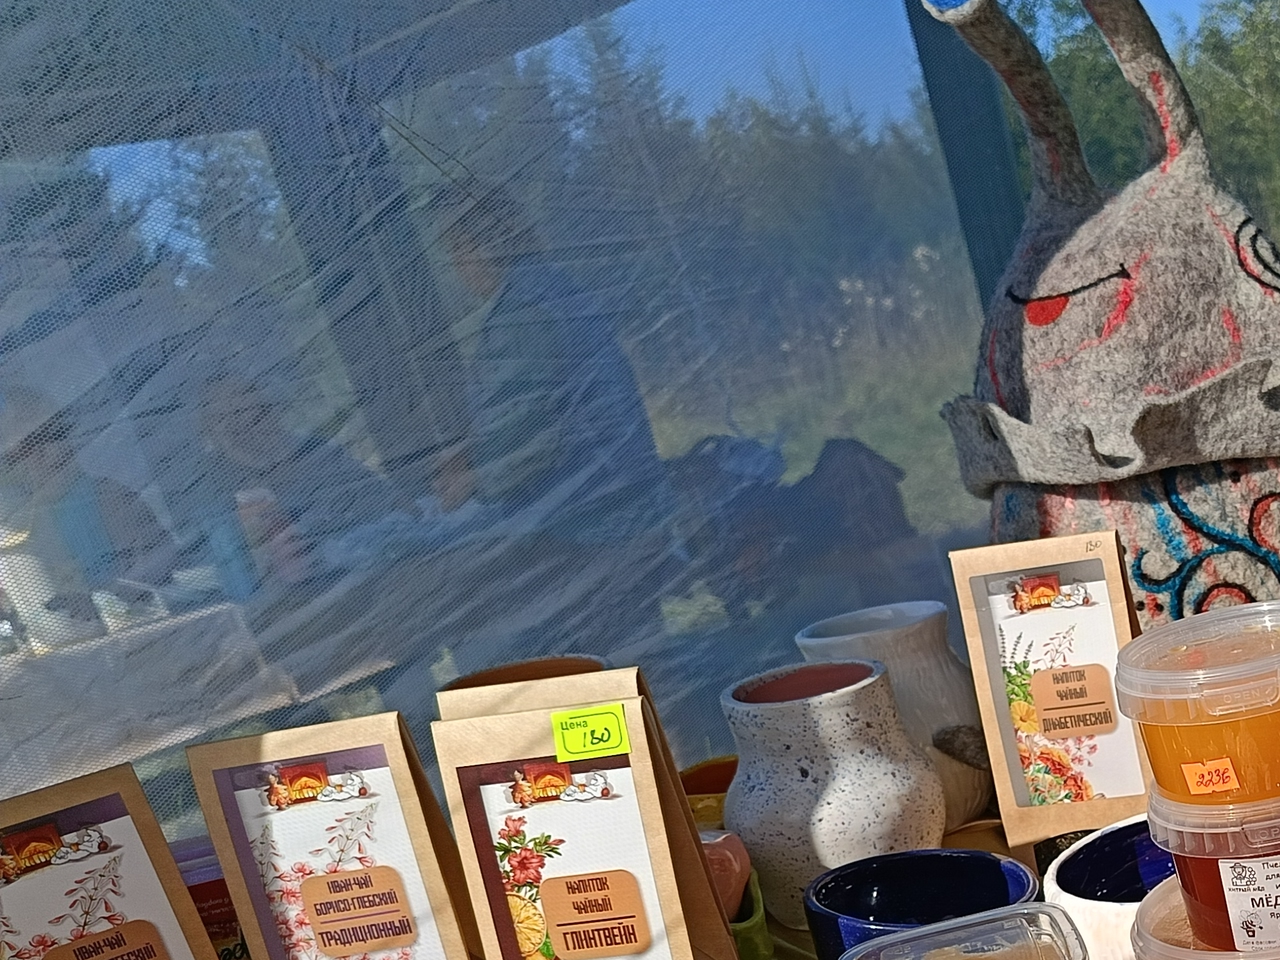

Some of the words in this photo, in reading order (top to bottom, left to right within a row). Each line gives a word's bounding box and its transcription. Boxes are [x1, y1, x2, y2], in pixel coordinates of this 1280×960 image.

[1052, 669, 1087, 685] НАПИТОК
[1223, 688, 1261, 704] OPEN
[560, 720, 588, 731] Цена
[1042, 708, 1113, 734] ДИАБЕТИЧЕСКИЙ
[583, 727, 611, 748] 180
[326, 873, 374, 894] ИВАН-ЧАЙ
[565, 876, 610, 895] НАПИТОК
[1265, 872, 1280, 881] для
[313, 888, 399, 916] БОРИСО-ГЛЕБСКИЙ
[572, 895, 613, 915] ЧАЙНЫЙ
[318, 915, 413, 948] ТРАДИЦИОННЫЙ
[562, 921, 638, 951] ГЛИНТВЕЙН
